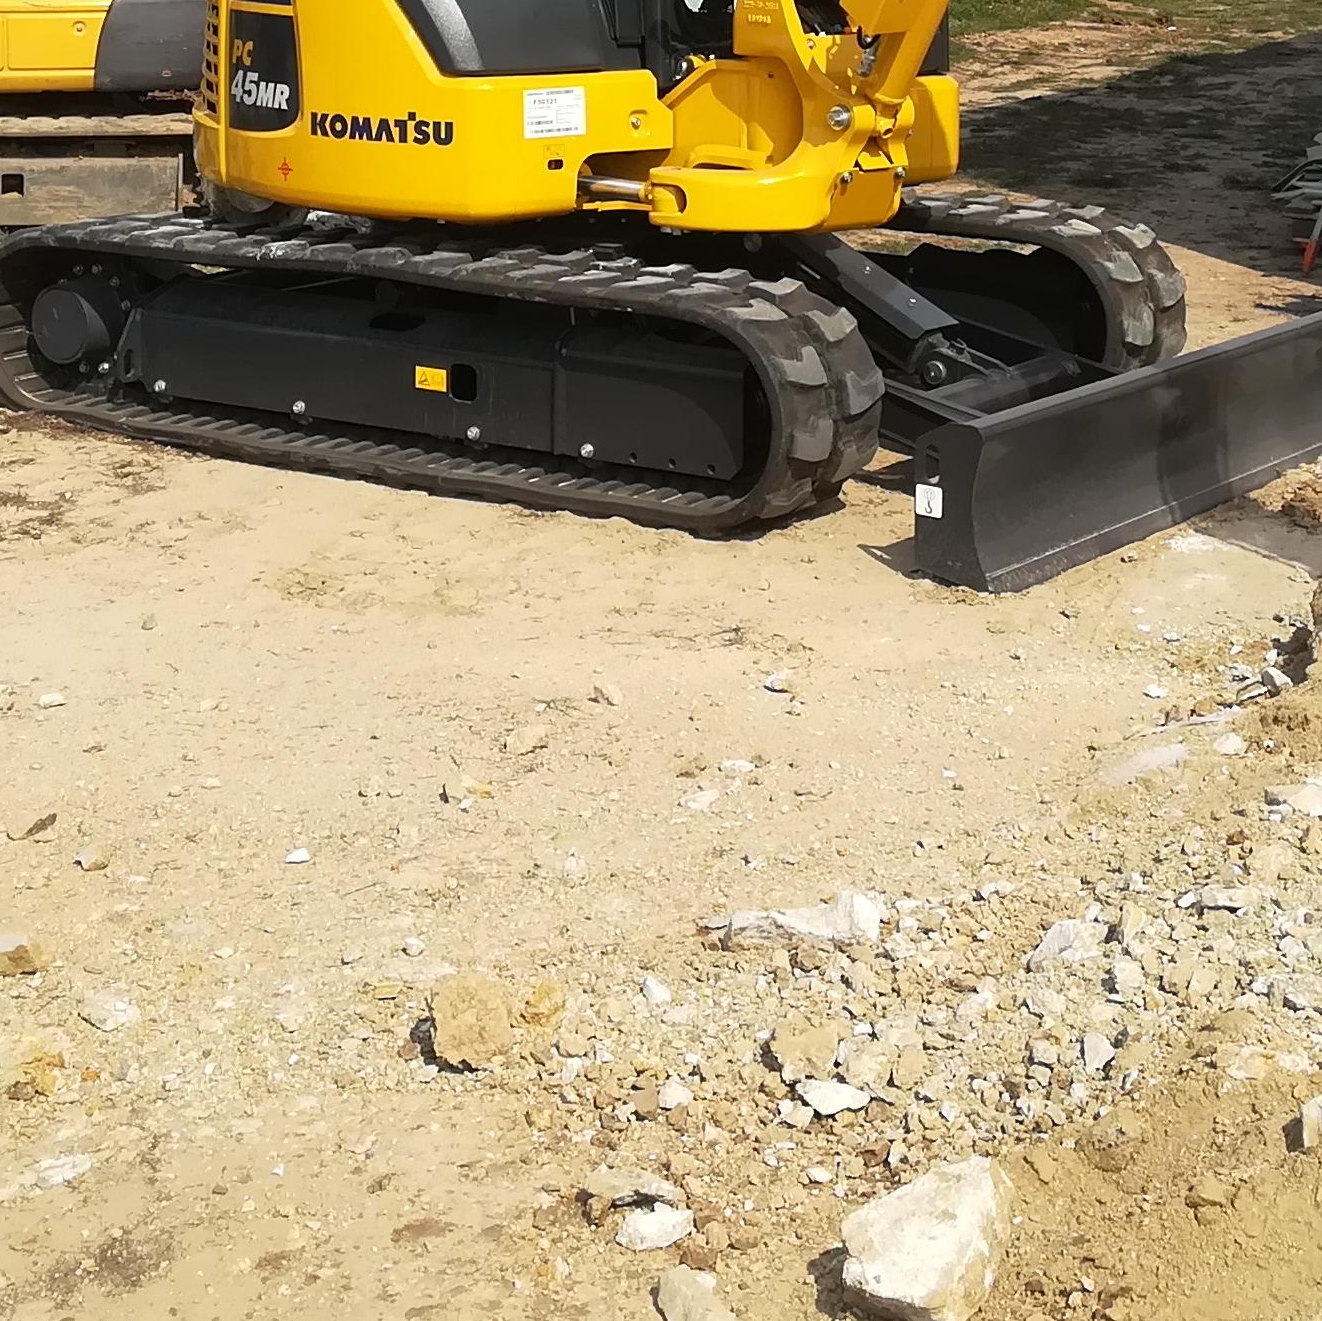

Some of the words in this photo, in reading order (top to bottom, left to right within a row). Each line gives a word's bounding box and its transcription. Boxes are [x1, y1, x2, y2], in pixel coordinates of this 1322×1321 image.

[232, 38, 254, 67] PC
[230, 69, 290, 110] 45MR
[310, 111, 454, 146] KOMATSU
